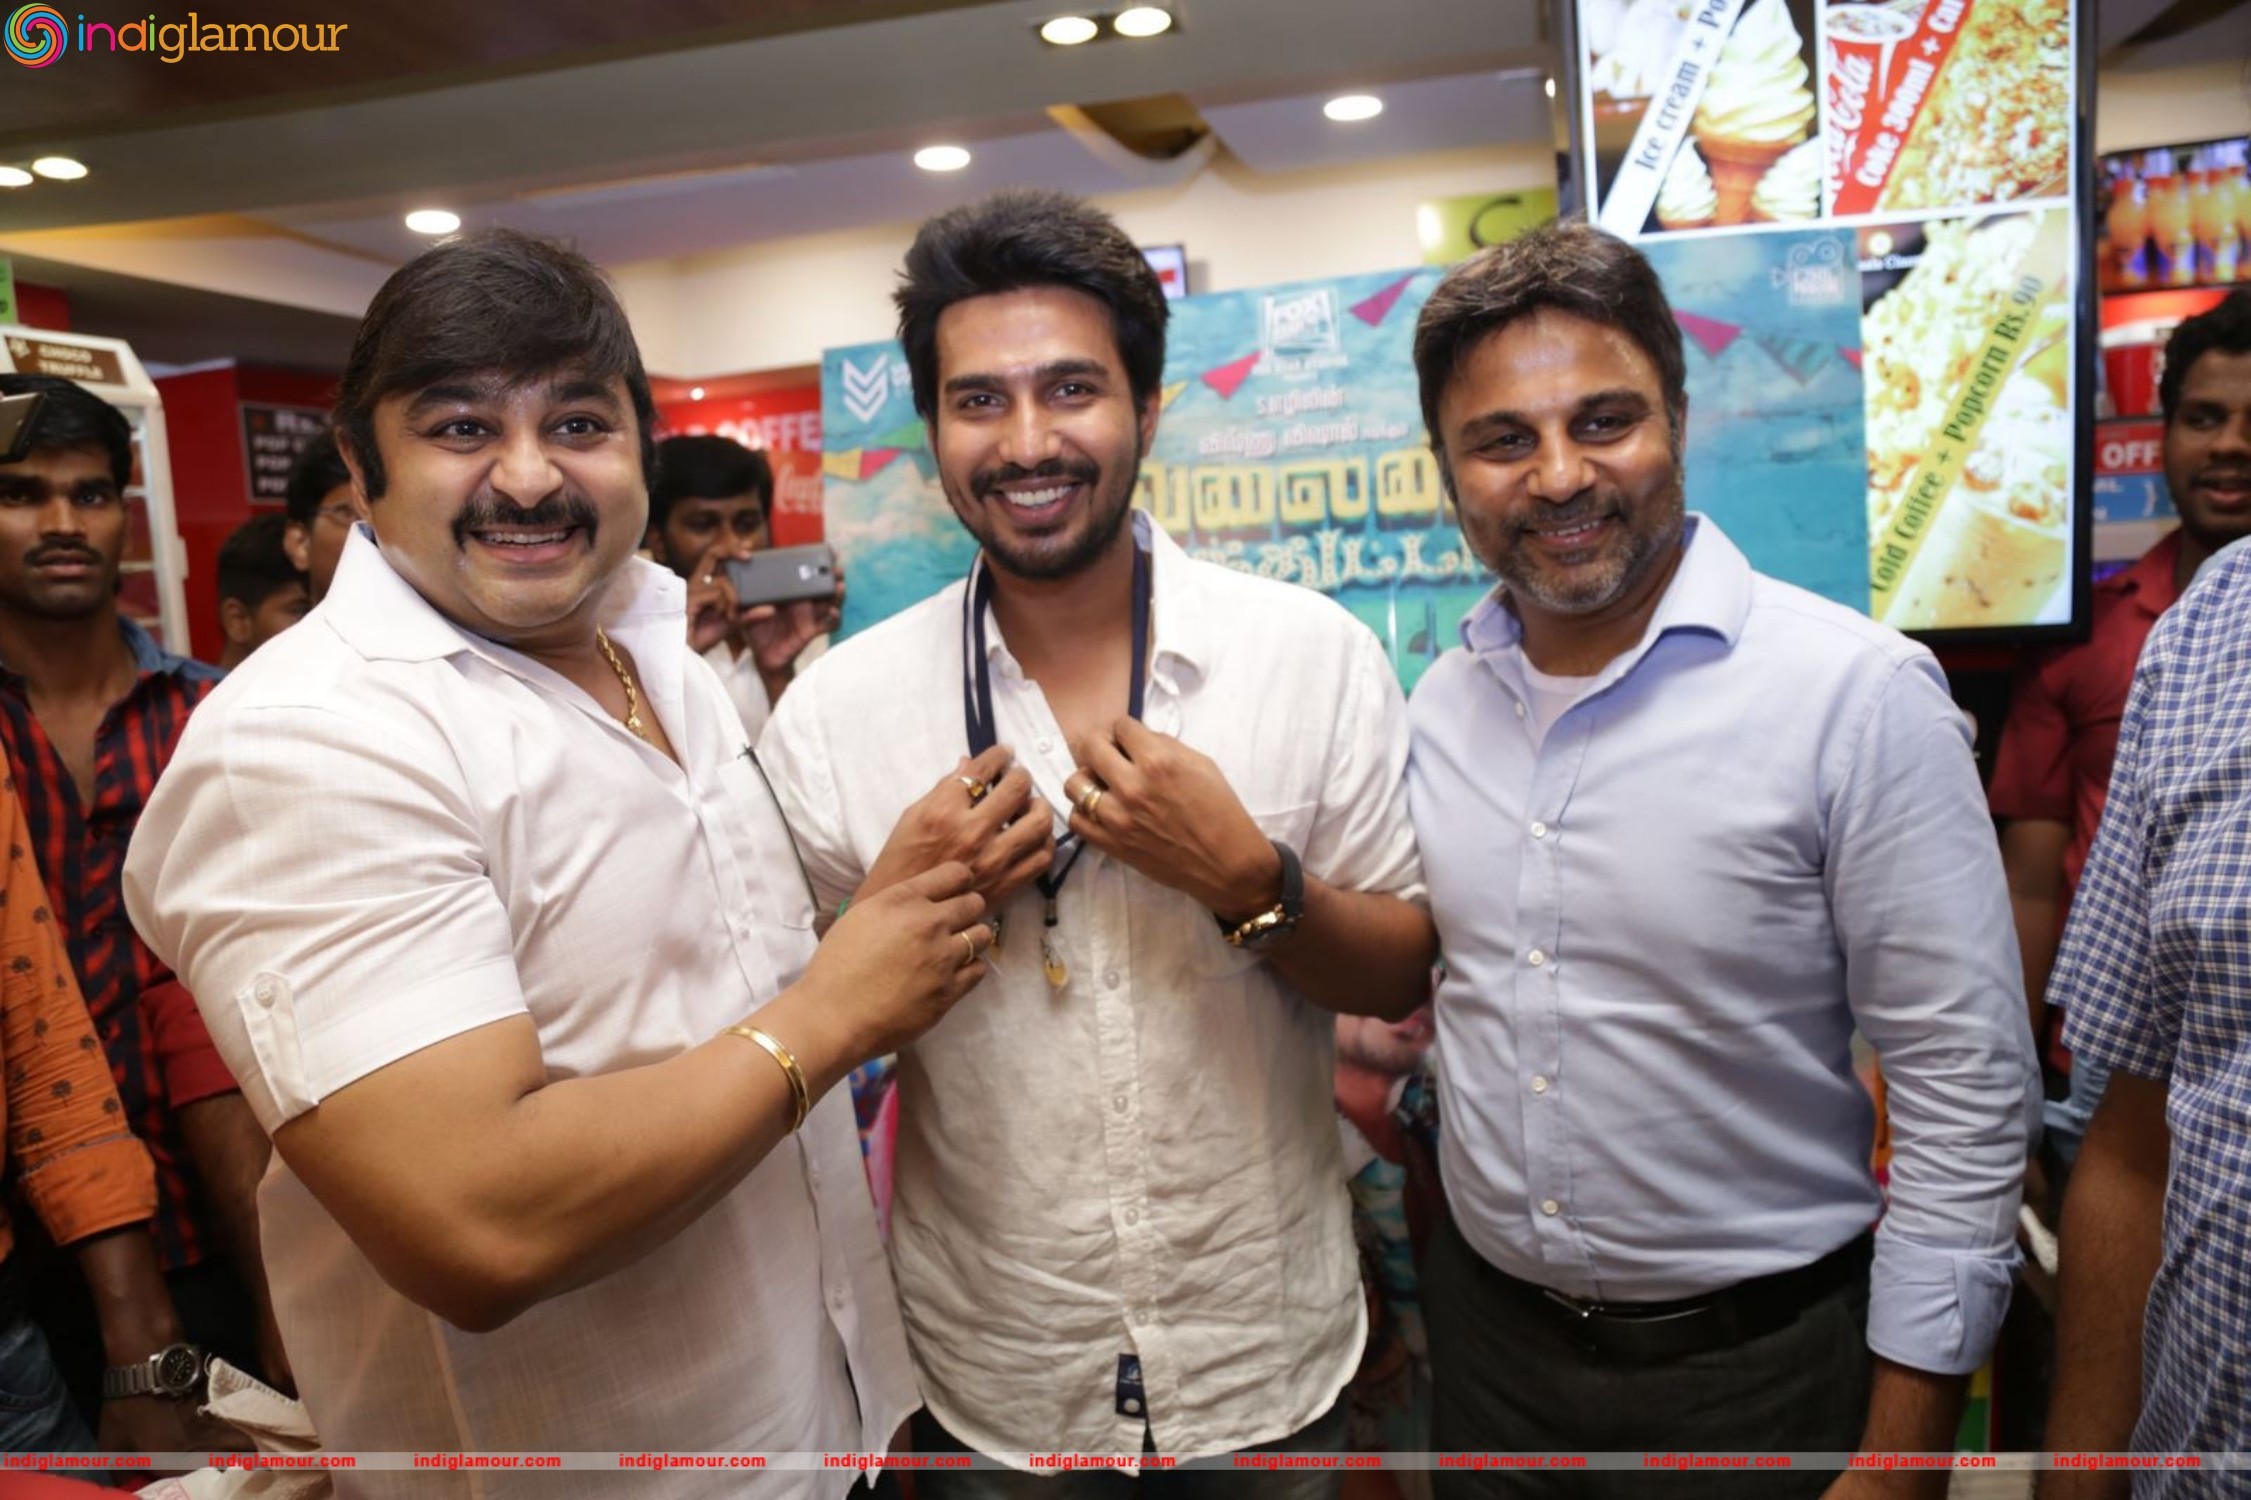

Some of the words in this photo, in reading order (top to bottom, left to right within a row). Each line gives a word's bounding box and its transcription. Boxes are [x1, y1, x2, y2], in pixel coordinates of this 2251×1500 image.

[1635, 137, 1665, 170] Ice
[1656, 60, 1700, 131] cream
[1855, 131, 1900, 187] Coke
[1880, 57, 1935, 132] 300ml
[1895, 472, 1946, 541] Coffee
[1943, 345, 2010, 443] Popcorn
[1993, 276, 2044, 343] Rs.90
